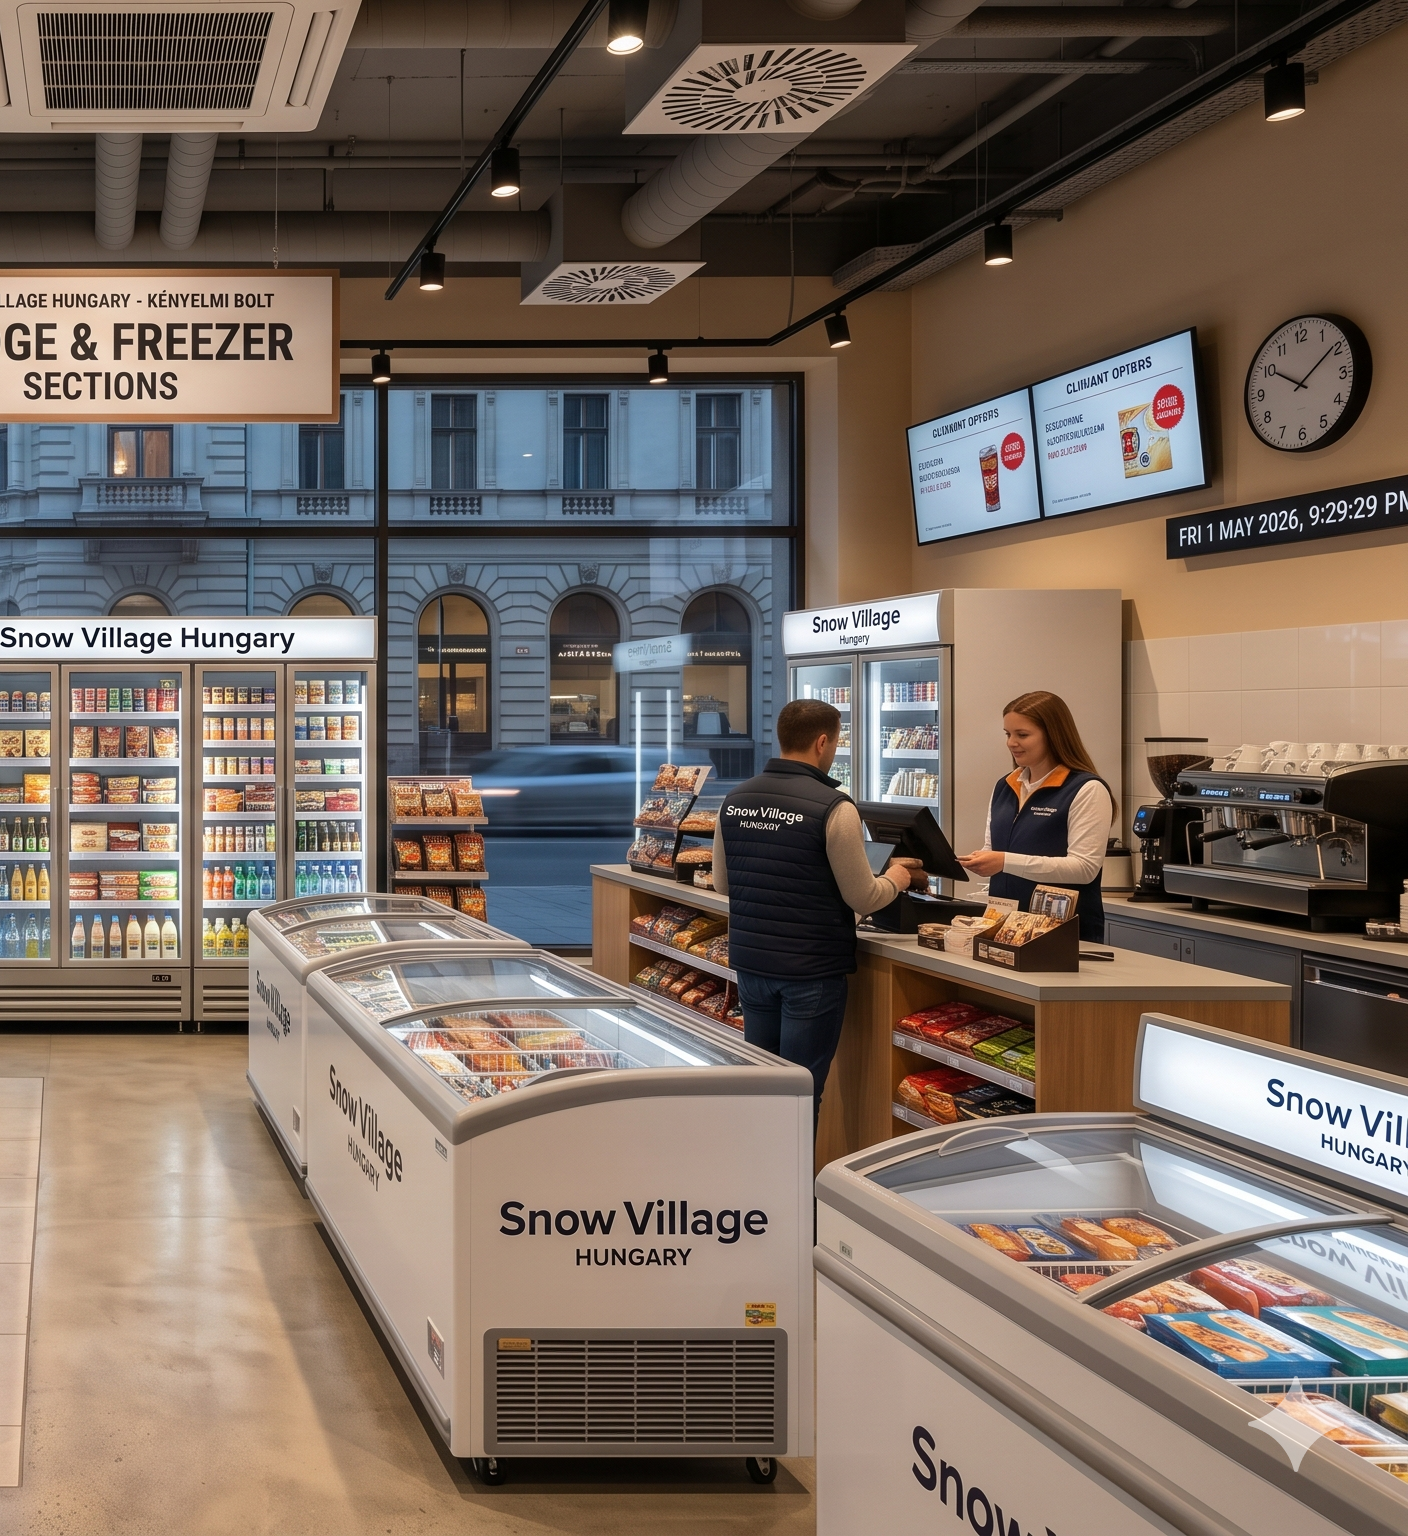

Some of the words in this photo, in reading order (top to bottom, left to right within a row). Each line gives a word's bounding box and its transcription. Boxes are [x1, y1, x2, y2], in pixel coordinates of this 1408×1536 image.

[52, 293, 131, 309] HUNGARY
[147, 290, 229, 309] KÉNYELMI
[234, 293, 275, 309] BOLT
[70, 322, 99, 361] &
[113, 323, 294, 361] FREEZER
[1295, 328, 1308, 344] 12
[1319, 329, 1324, 342] 1
[1277, 343, 1286, 357] 11
[1334, 341, 1343, 356] 2
[1264, 363, 1276, 378] 10
[1339, 365, 1347, 380] 3
[23, 371, 178, 401] SECTIONS
[1257, 389, 1265, 402] 9
[1333, 392, 1343, 405] 4
[1263, 411, 1272, 423] 8
[1319, 414, 1328, 428] 5
[1279, 425, 1287, 439] 7
[1298, 427, 1307, 440] 6
[1179, 525, 1202, 547] FRI
[1206, 523, 1213, 542] 1
[1219, 515, 1255, 541] MAY
[1258, 508, 1304, 535] 2026,
[1309, 495, 1378, 526] 9:29:29
[812, 615, 849, 634] Snow
[852, 608, 901, 631] Village
[0, 627, 74, 648] Snow
[81, 627, 173, 655] Village
[181, 627, 295, 655] Hungary
[725, 805, 759, 818] Snow
[760, 807, 804, 825] Village
[1266, 1078, 1352, 1129] Snow
[329, 1064, 358, 1127] Snow
[359, 1096, 403, 1182] Village
[499, 1200, 617, 1236] Snow
[622, 1199, 769, 1245] Village
[576, 1248, 692, 1267] HUNGARY
